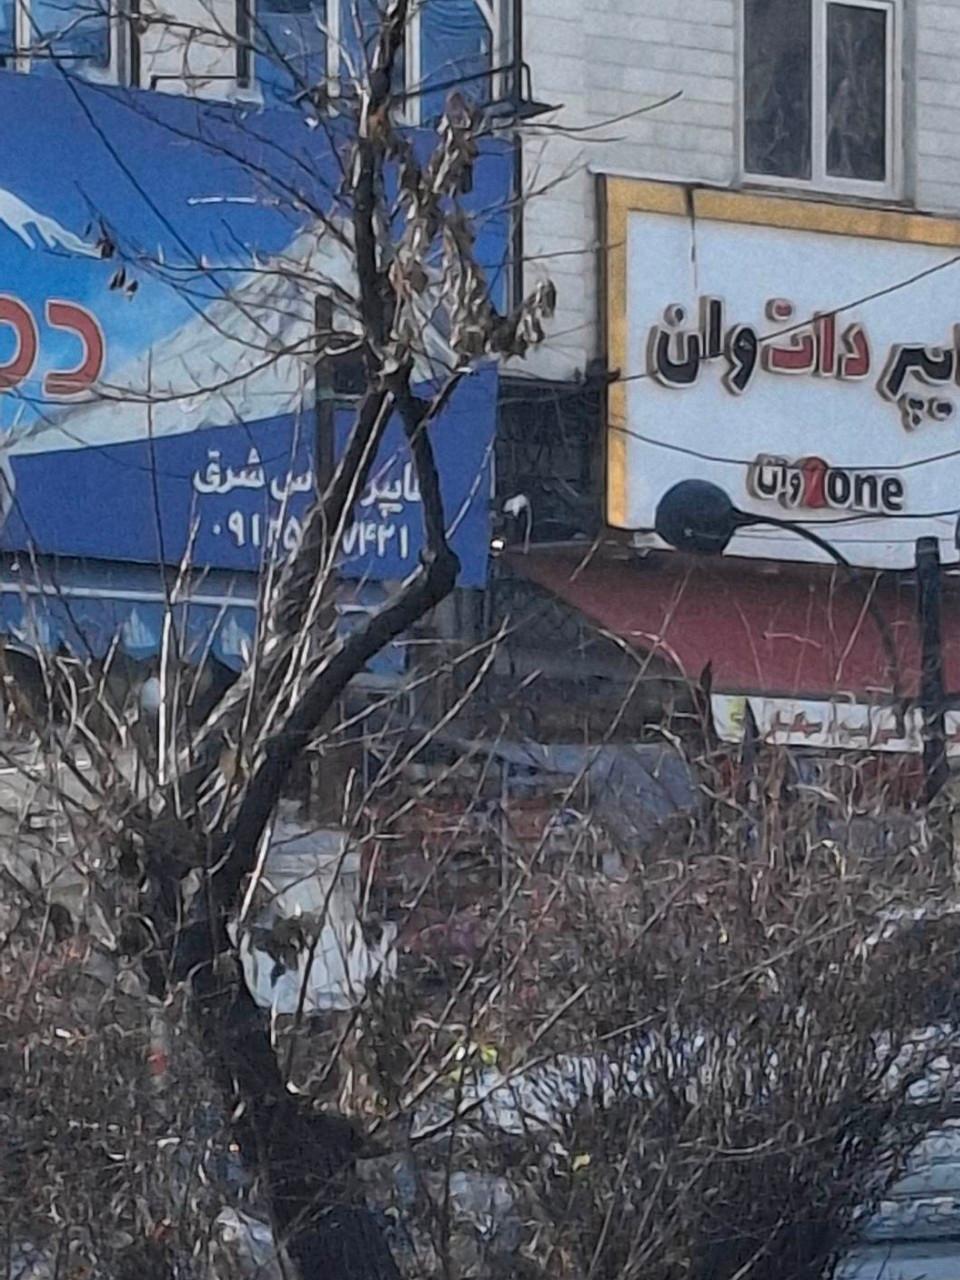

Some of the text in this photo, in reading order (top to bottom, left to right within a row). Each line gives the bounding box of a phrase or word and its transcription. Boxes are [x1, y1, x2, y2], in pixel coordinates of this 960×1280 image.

[647, 295, 759, 396] وان
[193, 447, 266, 494] شرق
[826, 468, 905, 513] one
